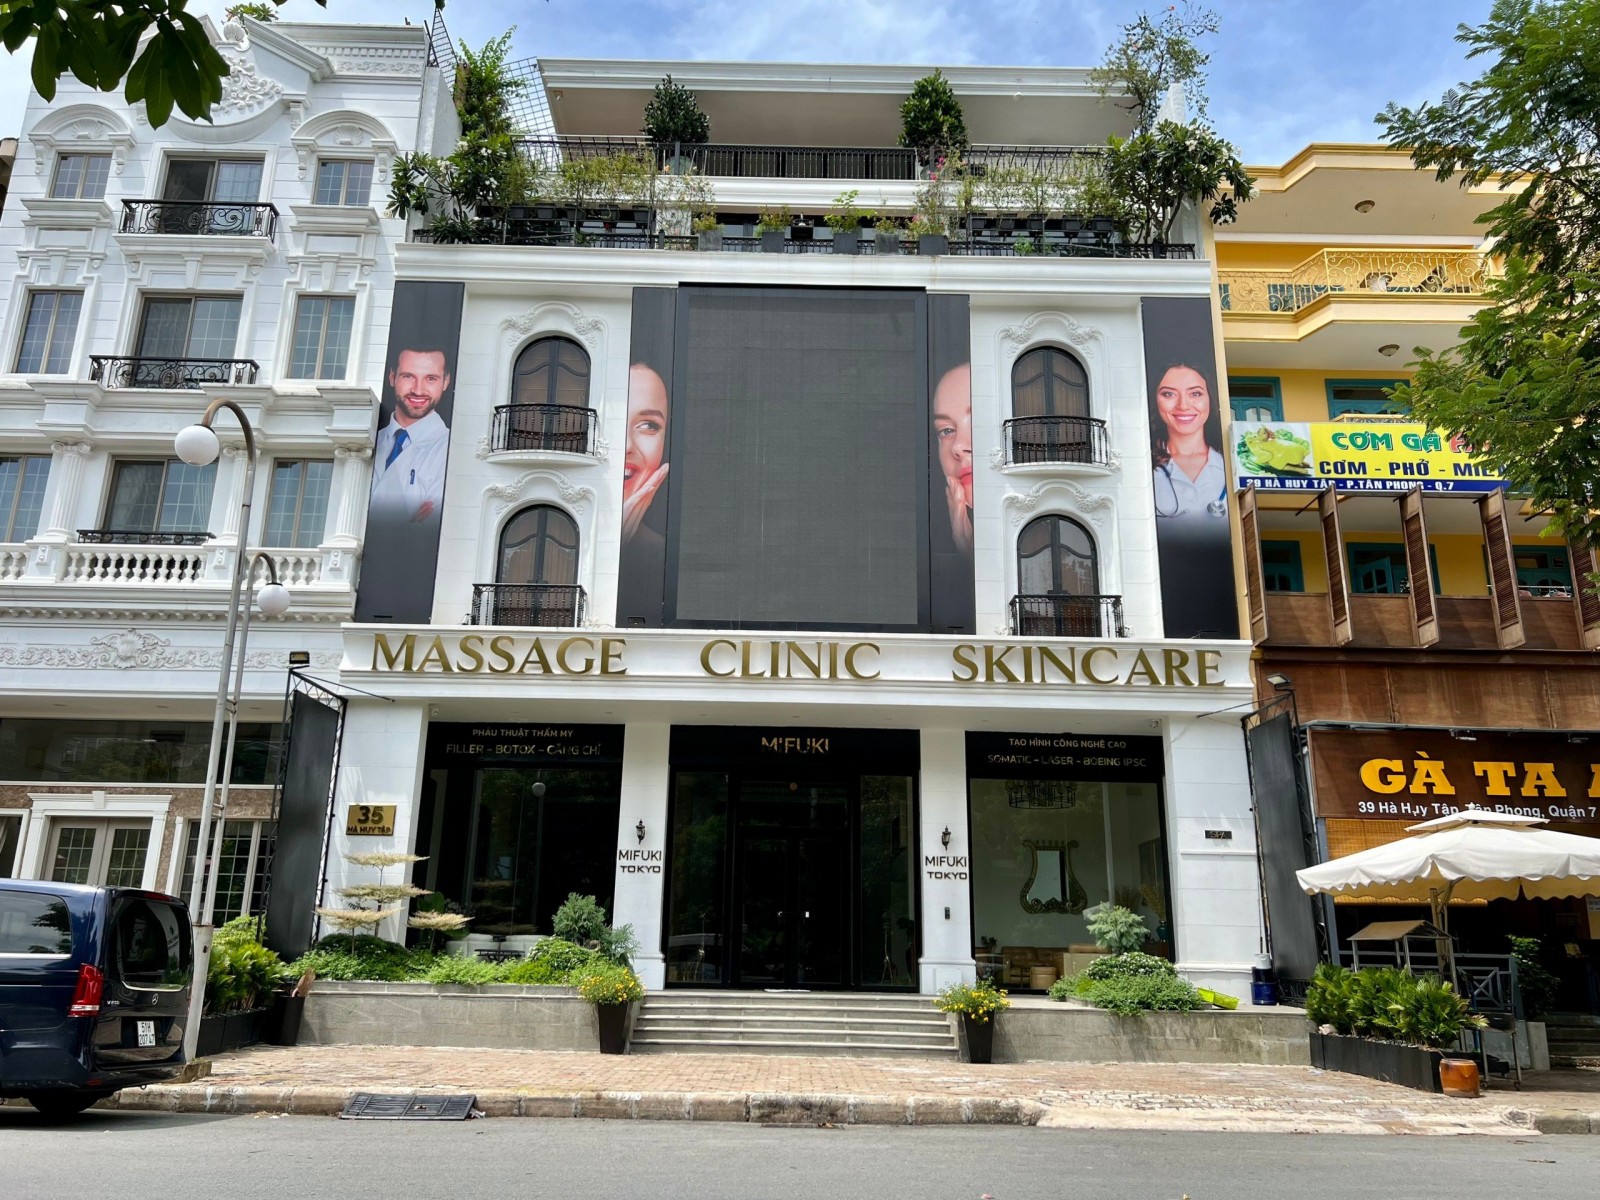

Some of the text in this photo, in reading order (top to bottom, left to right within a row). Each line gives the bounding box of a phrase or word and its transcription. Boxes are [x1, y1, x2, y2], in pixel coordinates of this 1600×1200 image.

[1331, 431, 1394, 450] CƠM
[1319, 459, 1367, 475] CƠM
[1388, 459, 1430, 476] PHỞ
[1265, 478, 1281, 488] HÀ
[1285, 479, 1307, 488] HUY
[1346, 479, 1382, 490] P.TÂN
[371, 633, 628, 675] MASSAGE
[700, 639, 881, 680] CLINIC
[952, 644, 1227, 687] SKINCARE
[446, 743, 484, 755] FILLER
[495, 744, 535, 755] BOTOX
[761, 736, 829, 754] MIFUKI
[1053, 737, 1079, 748] CÔNG
[1108, 740, 1127, 749] CAO
[987, 754, 1032, 764] SOMATIC
[1042, 755, 1074, 766] LASER
[1083, 756, 1121, 767] BOEING
[1360, 751, 1456, 795] GÀ
[1473, 761, 1567, 797] TA
[356, 805, 384, 825] 35
[1358, 801, 1375, 813] 39
[1378, 801, 1398, 814] Hà
[1548, 804, 1585, 819] Quận
[1588, 806, 1597, 818] 7
[618, 850, 662, 861] MIFUKI
[925, 856, 967, 867] MIFUKI
[620, 865, 661, 873] TOKYO
[927, 871, 967, 880] TOKYO
